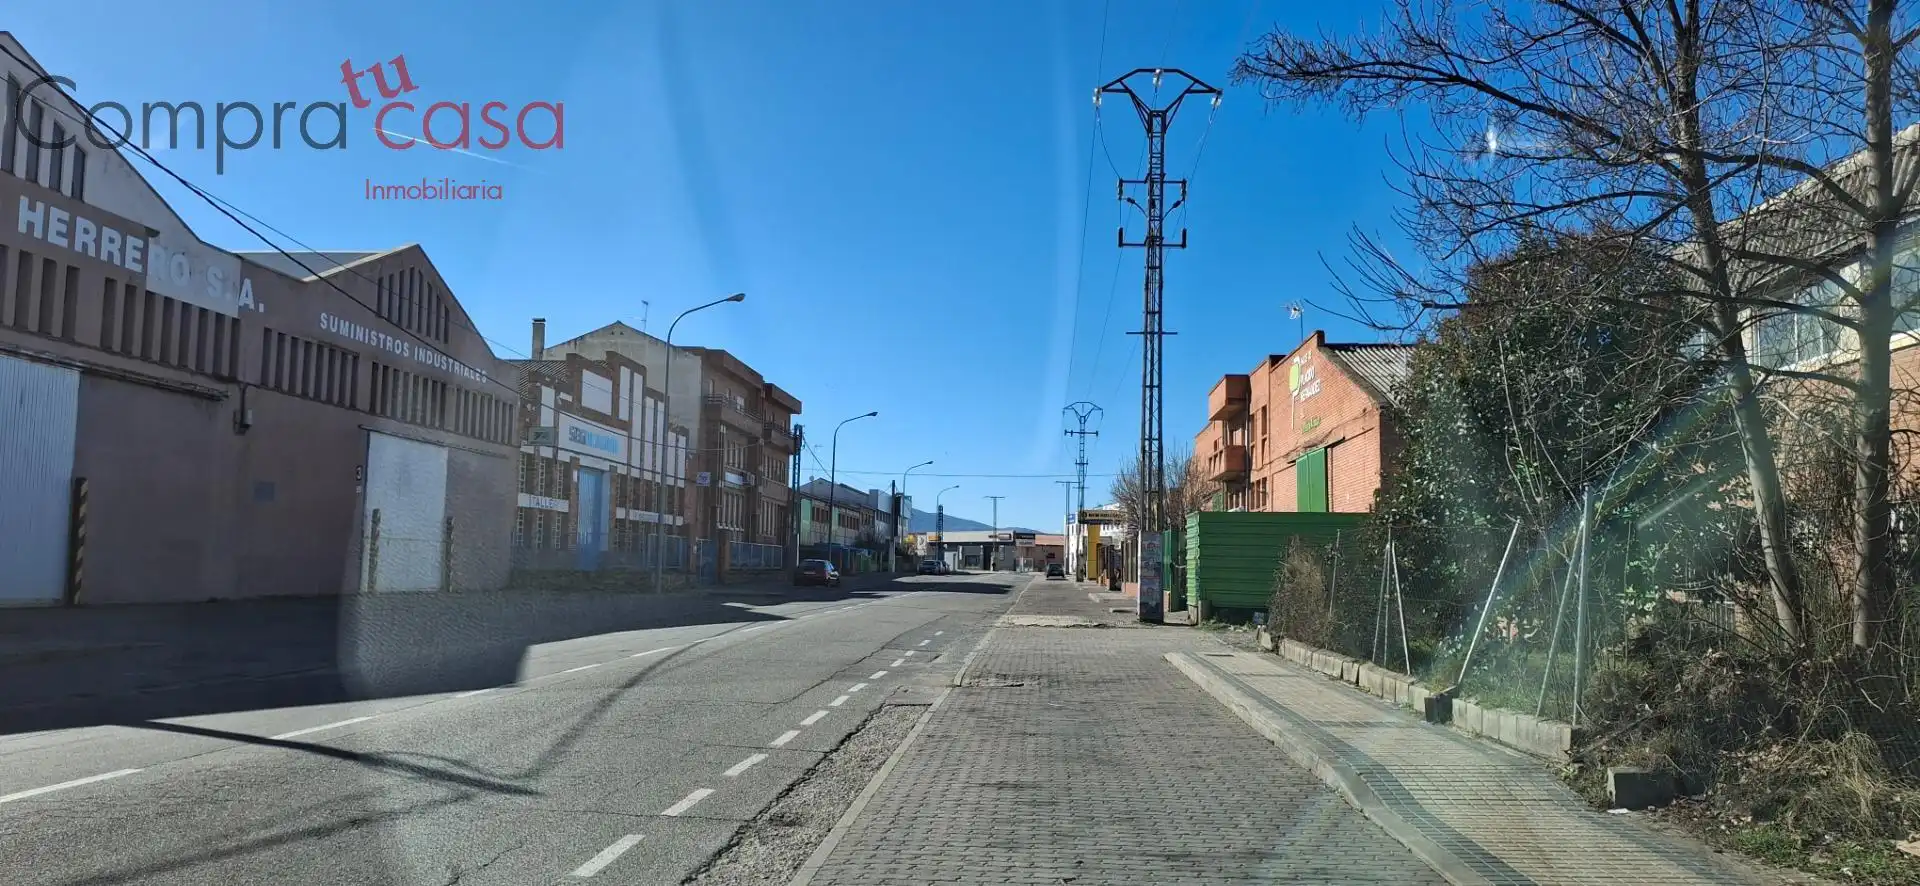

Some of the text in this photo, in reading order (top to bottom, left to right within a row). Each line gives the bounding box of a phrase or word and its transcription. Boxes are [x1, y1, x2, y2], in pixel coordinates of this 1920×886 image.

[18, 194, 192, 286] HERRERO
[319, 312, 488, 384] SUMINISTROS INDUSTRIALES
